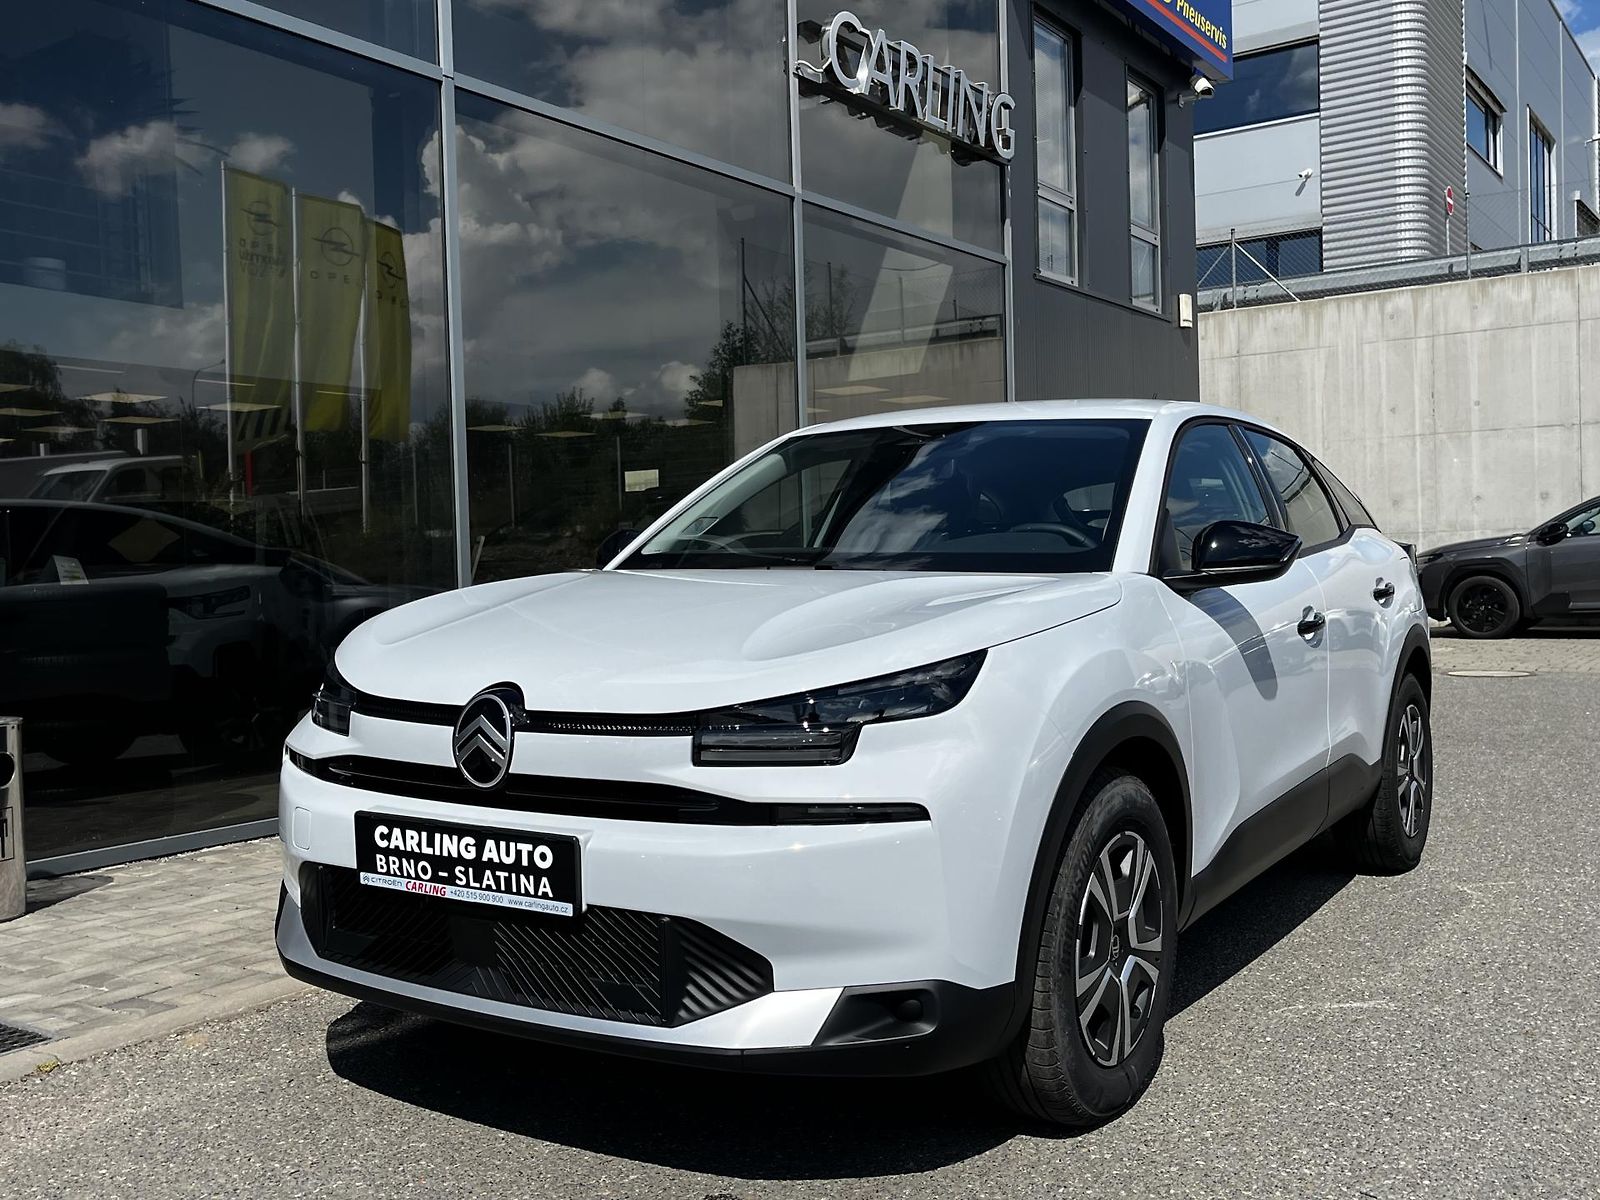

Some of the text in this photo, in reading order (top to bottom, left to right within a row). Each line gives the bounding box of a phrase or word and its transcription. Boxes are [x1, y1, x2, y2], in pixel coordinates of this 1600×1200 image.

[1176, 0, 1227, 49] Pneuservis
[829, 11, 1016, 159] CARLING
[374, 825, 554, 870] CARLING AUTO
[375, 854, 432, 880] BRNO
[454, 866, 554, 898] SLATINA
[405, 880, 447, 897] CARLING
[450, 889, 465, 898] +420
[466, 890, 478, 900] 515
[479, 892, 491, 902] 900
[491, 894, 504, 903] 900
[508, 898, 569, 913] www.carlingauto.cz
